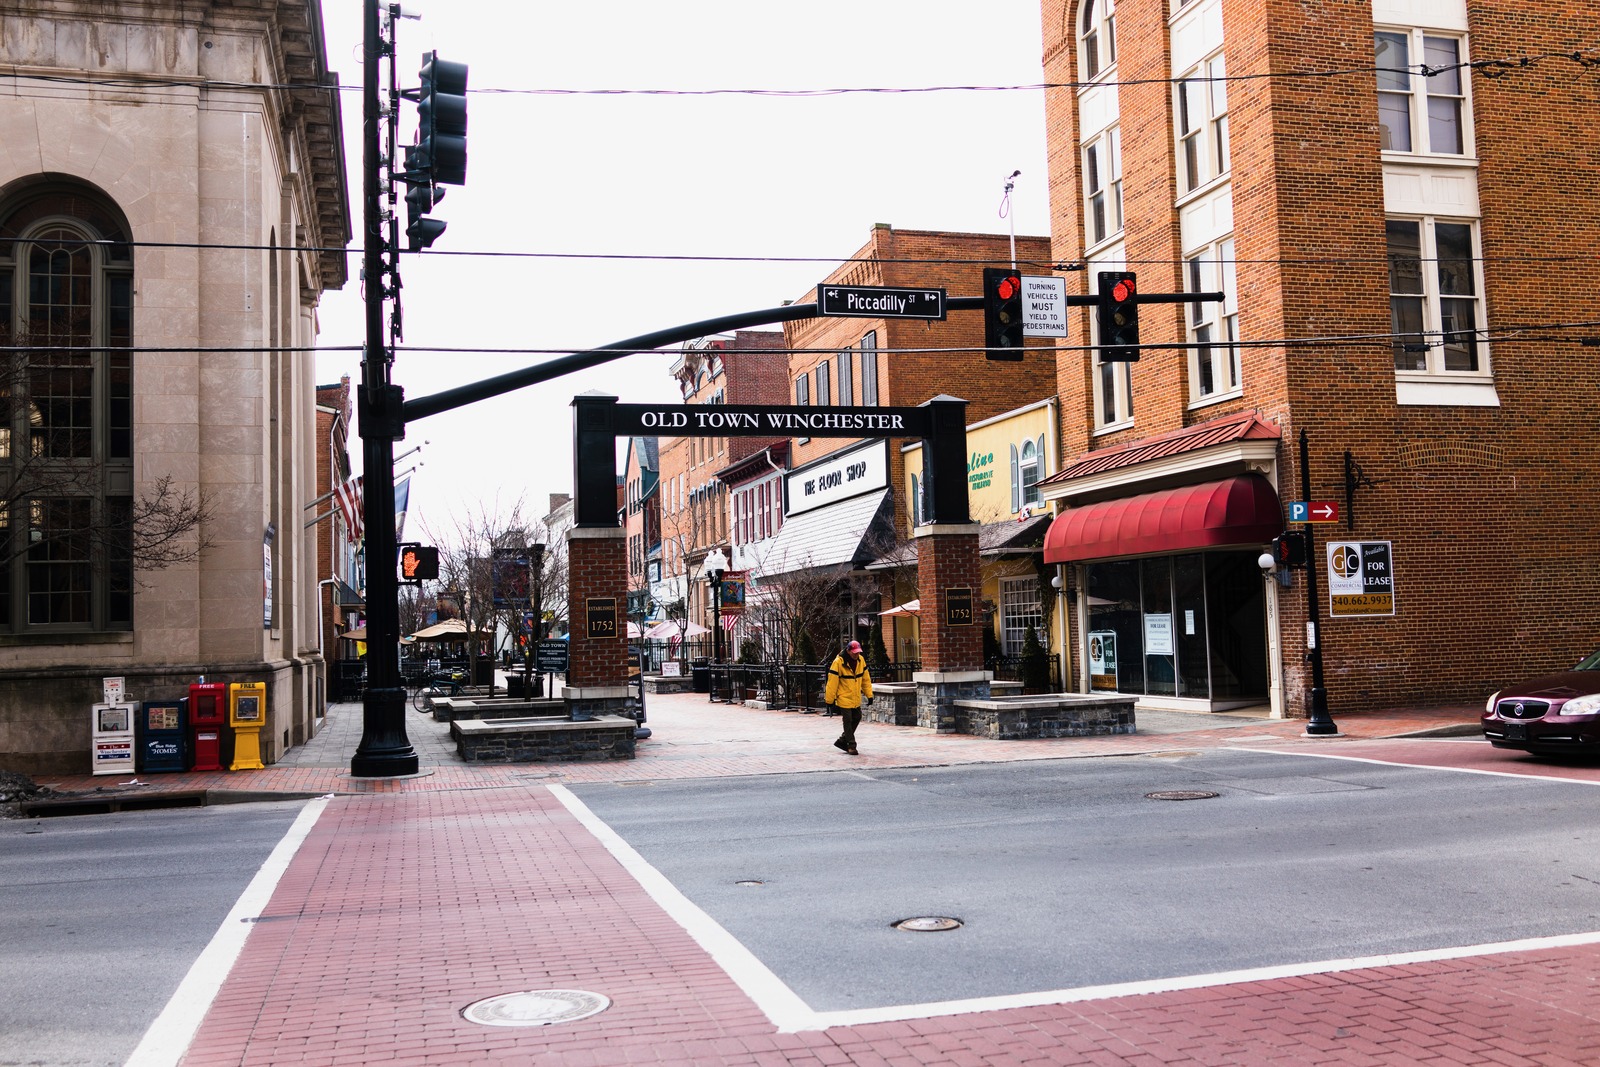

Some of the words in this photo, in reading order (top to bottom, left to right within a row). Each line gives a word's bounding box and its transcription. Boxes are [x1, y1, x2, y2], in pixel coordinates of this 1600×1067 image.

[834, 289, 839, 298] E
[847, 293, 906, 314] Piccadilly
[908, 294, 916, 303] ST
[1031, 302, 1054, 311] MUST
[1022, 322, 1065, 330] PEDESTRIANS
[641, 412, 688, 427] OLD
[694, 412, 760, 428] TOWN
[766, 413, 905, 429] WINCHESTER
[804, 479, 816, 497] THE
[819, 470, 842, 491] FLOOR
[846, 461, 867, 482] SHOP
[1293, 504, 1304, 520] P
[1367, 562, 1385, 571] FOR
[1363, 576, 1391, 586] LEASE
[1332, 595, 1393, 606] 540.662.9937
[951, 609, 970, 619] 1752
[592, 620, 614, 631] 1752
